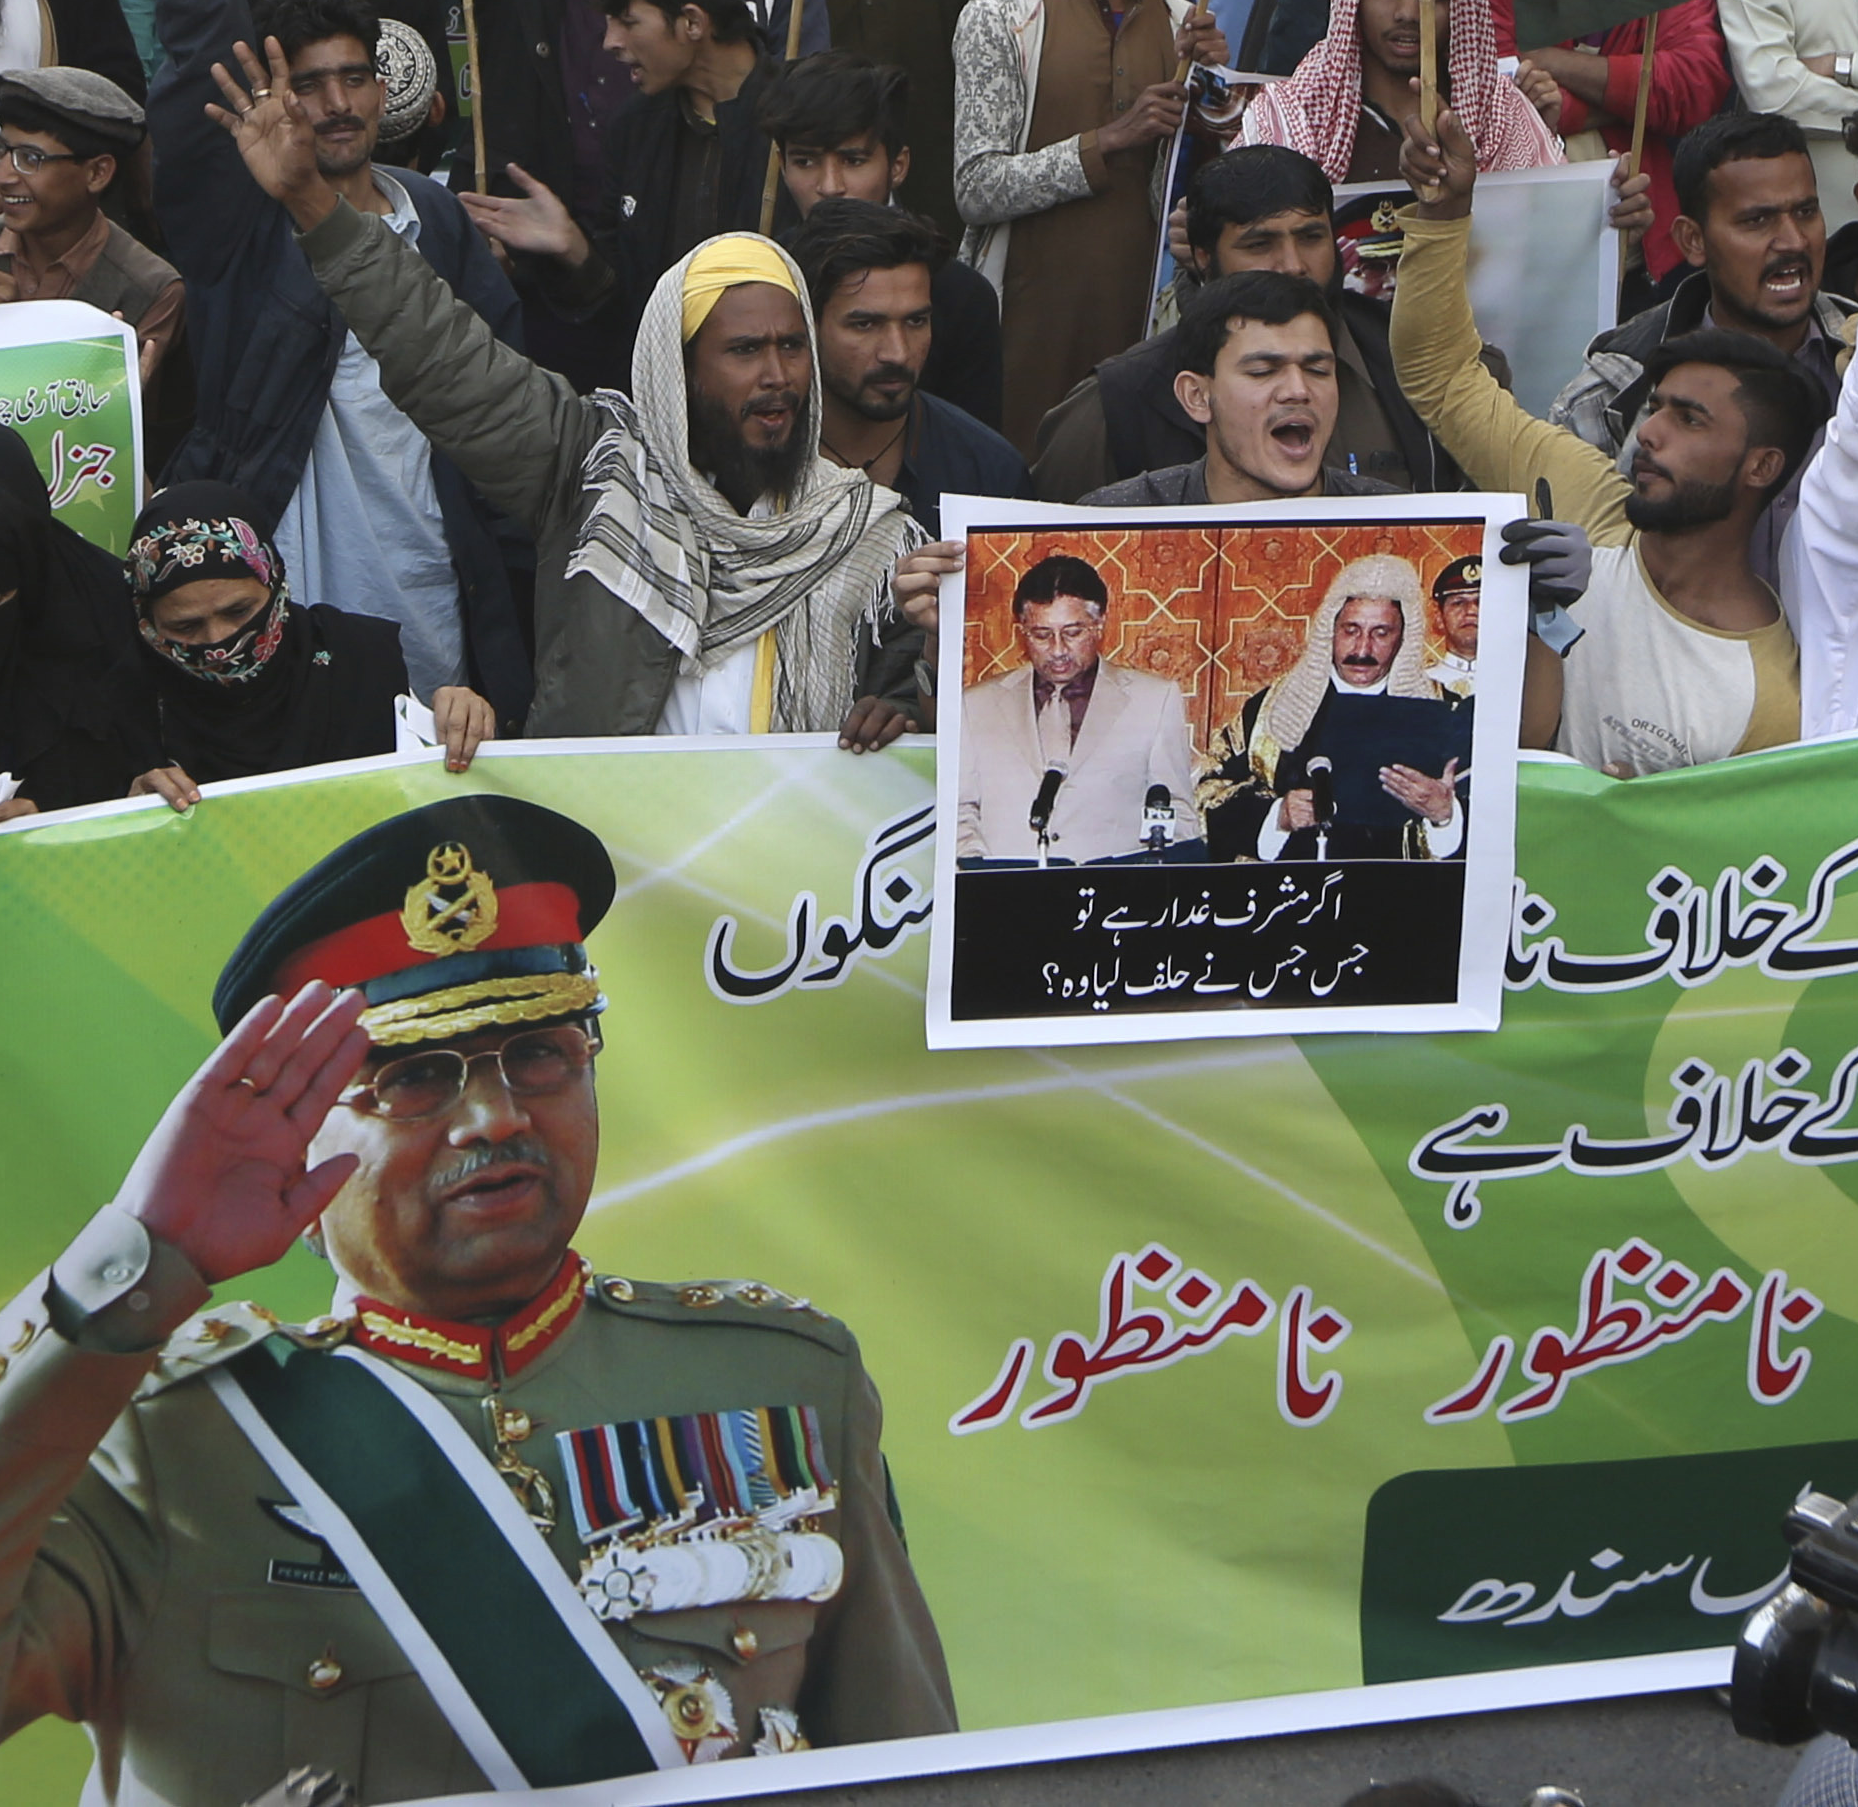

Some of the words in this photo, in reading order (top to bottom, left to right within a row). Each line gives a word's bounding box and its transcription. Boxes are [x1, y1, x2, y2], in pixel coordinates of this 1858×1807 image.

[13, 380, 60, 425] آرمی
[59, 378, 111, 418] سابق
[1631, 718, 1690, 758] ORIGINAL
[1146, 807, 1172, 820] Ptv
[1073, 888, 1096, 931] تو
[1151, 890, 1210, 928] غدار
[1213, 876, 1309, 934] مشرف
[1296, 870, 1344, 925] اگر
[1543, 855, 1801, 989] خلاف
[1101, 905, 1148, 946] ہے
[1093, 957, 1121, 1010] لیا
[1124, 955, 1191, 996] حلف
[1193, 951, 1240, 994] نے
[1248, 945, 1308, 998] جس
[1310, 943, 1369, 997] جس
[1562, 1045, 1827, 1172] خلاف
[1408, 1098, 1566, 1229] ہے
[1435, 1548, 1695, 1626] سندھ
